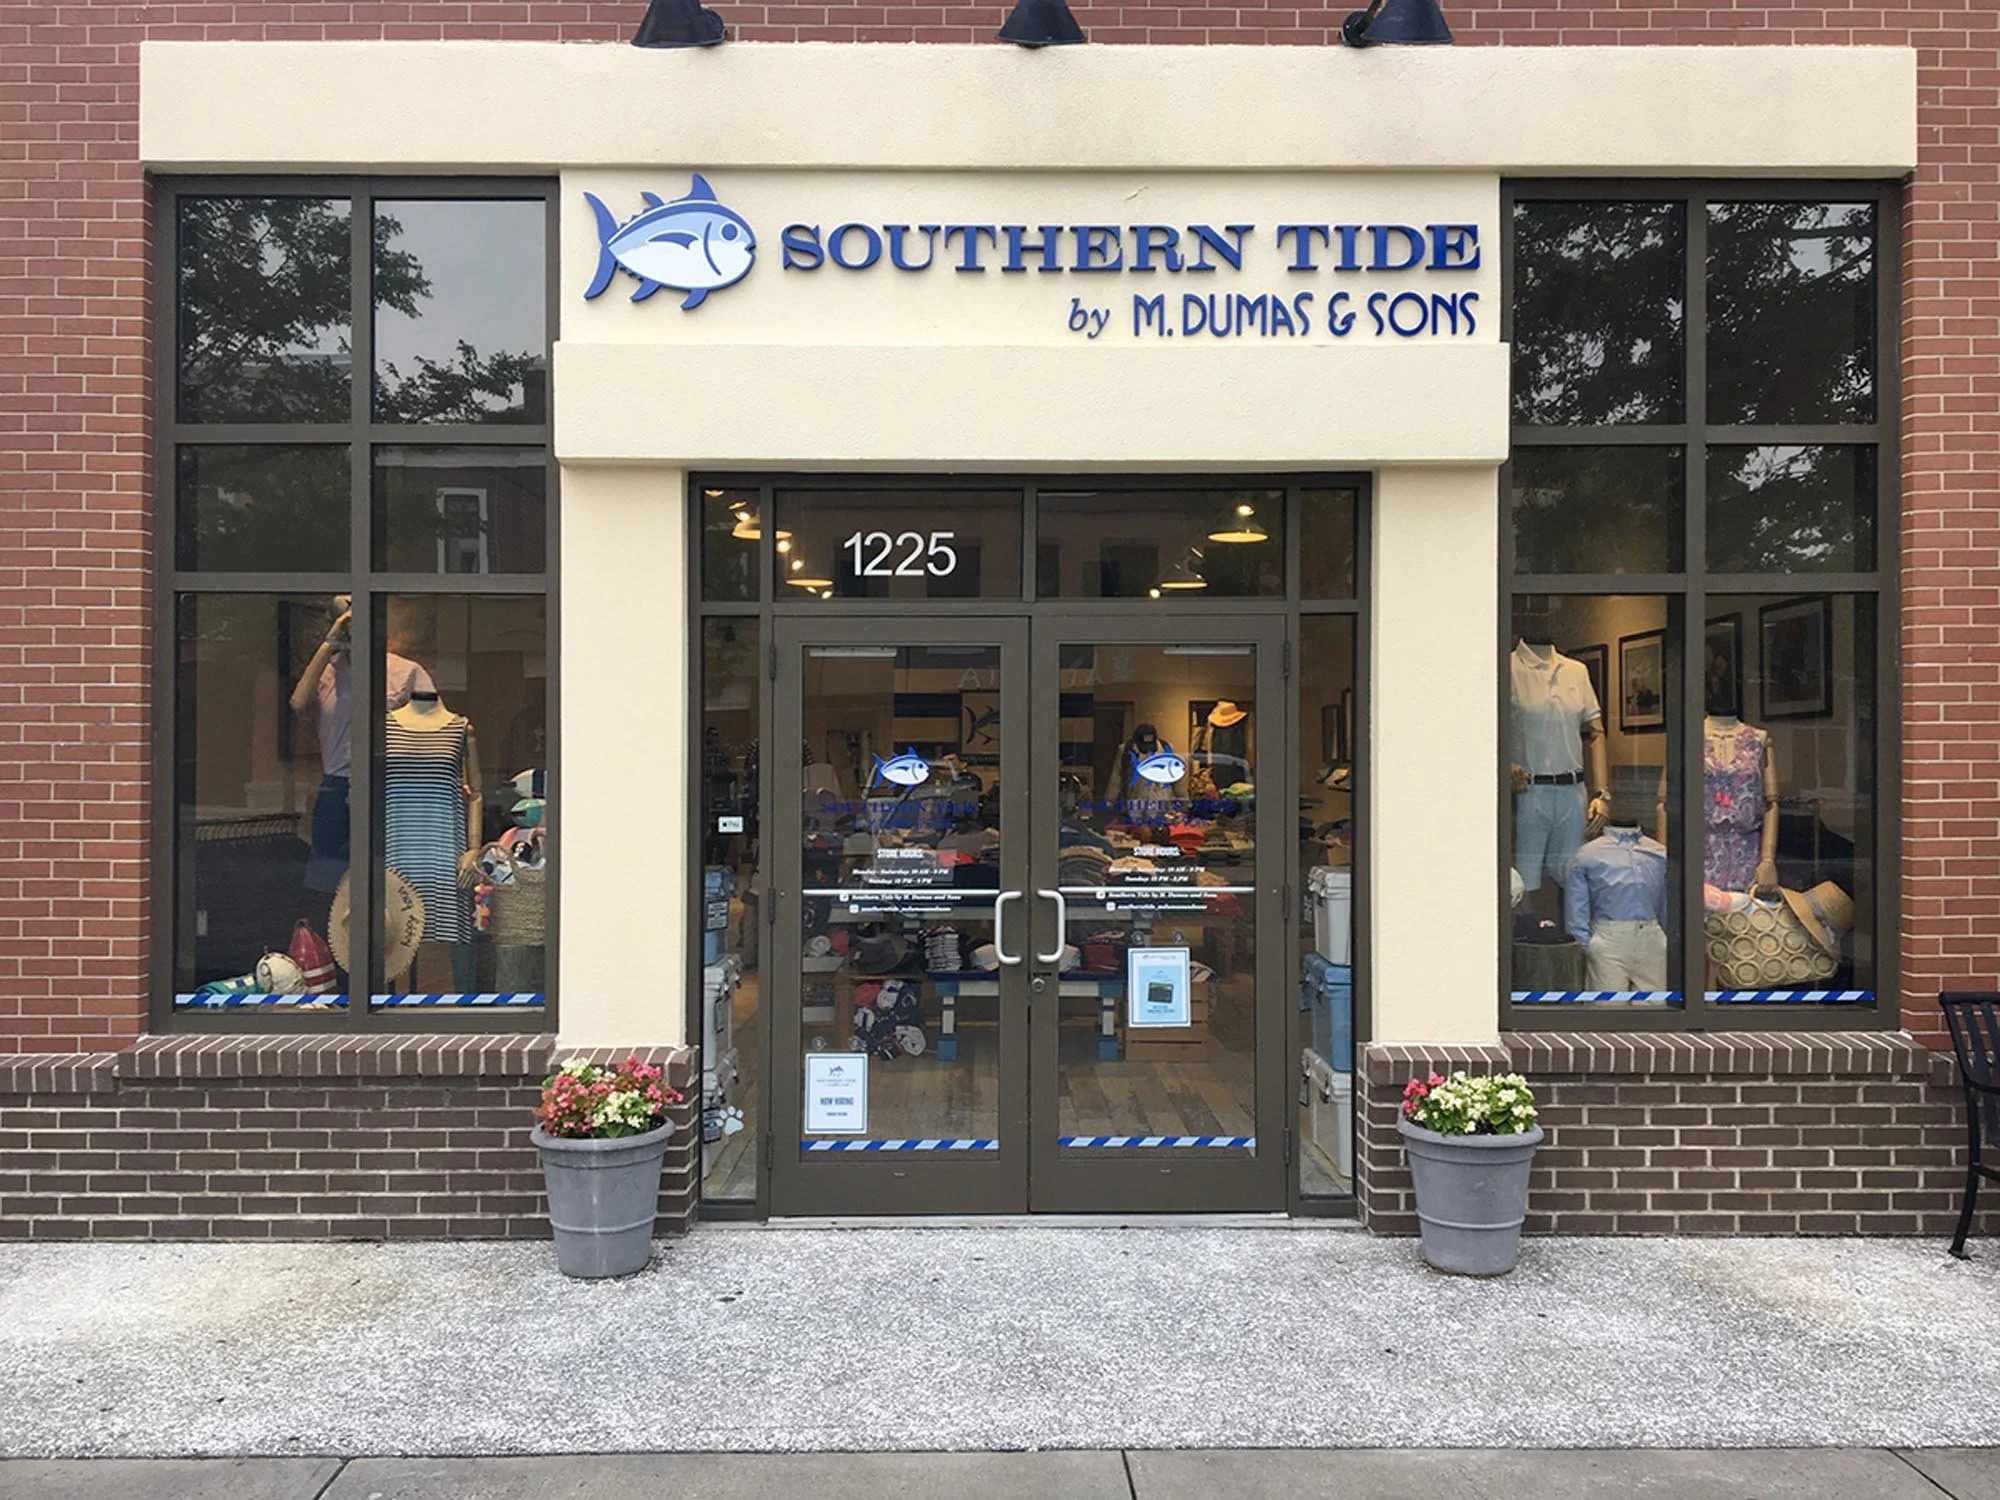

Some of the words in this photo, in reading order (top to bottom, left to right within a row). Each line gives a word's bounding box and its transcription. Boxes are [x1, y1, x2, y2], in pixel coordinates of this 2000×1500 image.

[781, 224, 1250, 270] SOUTHERN
[1277, 224, 1480, 270] TIDE
[1068, 298, 1112, 339] by
[1134, 293, 1173, 336] M.
[1182, 292, 1312, 337] DUMAS
[1328, 291, 1356, 337] &
[1367, 291, 1478, 337] SONS
[844, 532, 957, 576] 1225
